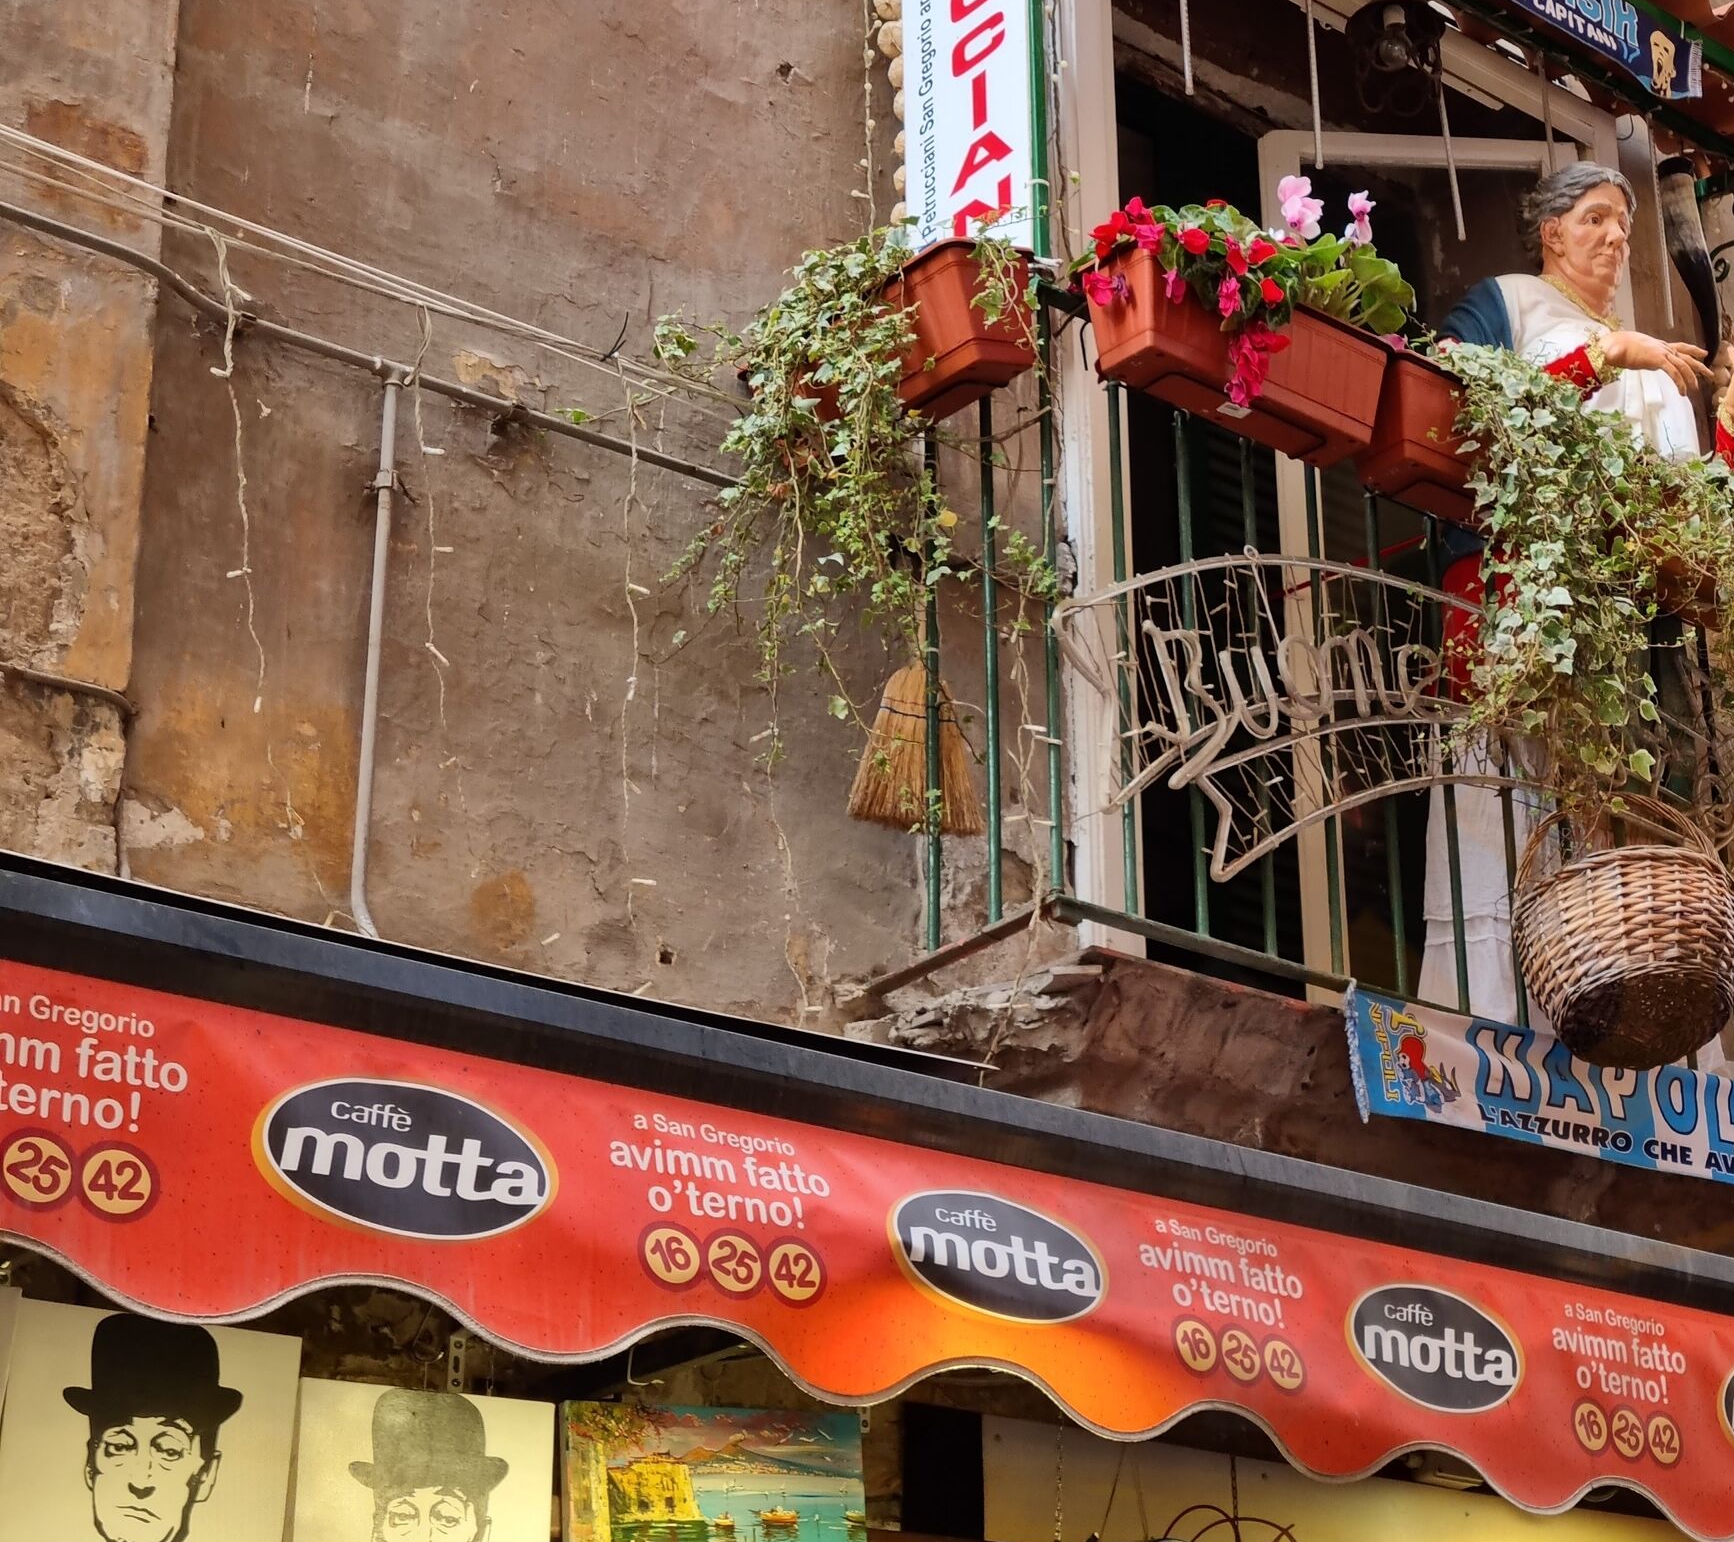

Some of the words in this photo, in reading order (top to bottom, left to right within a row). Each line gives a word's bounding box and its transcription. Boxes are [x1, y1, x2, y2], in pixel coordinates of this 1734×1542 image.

[917, 18, 937, 96] Gregorio
[920, 96, 935, 132] San
[921, 134, 936, 243] Petrucciani
[29, 994, 155, 1038] Gregorio
[75, 1037, 189, 1092] fatto
[330, 1100, 413, 1133] caffè
[633, 1113, 649, 1131] a
[653, 1112, 696, 1139] San
[700, 1123, 796, 1157] Gregorio
[1479, 1102, 1633, 1154] L'AZZURRO
[1643, 1137, 1694, 1167] CHE
[6, 1141, 69, 1195] 25
[88, 1159, 145, 1201] 42
[280, 1126, 546, 1206] motta
[609, 1138, 737, 1184] avimm
[742, 1156, 831, 1198] fatto
[935, 1206, 998, 1233] caffè
[1155, 1218, 1168, 1234] a
[1168, 1218, 1203, 1243] San
[1204, 1225, 1279, 1259] Gregorio
[650, 1235, 692, 1273] 16
[711, 1239, 759, 1285] 25
[773, 1252, 817, 1289] 42
[909, 1225, 1101, 1298] motta
[1139, 1241, 1237, 1284] avimm
[1239, 1257, 1304, 1300] fatto
[1384, 1302, 1434, 1327] caffè
[1564, 1302, 1574, 1318] a
[1575, 1302, 1603, 1324] San
[1604, 1308, 1665, 1337] Gregorio
[1180, 1327, 1211, 1362] 16
[1222, 1333, 1257, 1374] 25
[1269, 1345, 1301, 1380] 42
[1364, 1323, 1518, 1387] motta
[1552, 1325, 1632, 1365] avimm
[1631, 1337, 1687, 1376] fatto
[1577, 1410, 1603, 1442] 16
[1613, 1413, 1642, 1452] 25
[1651, 1423, 1678, 1455] 42
